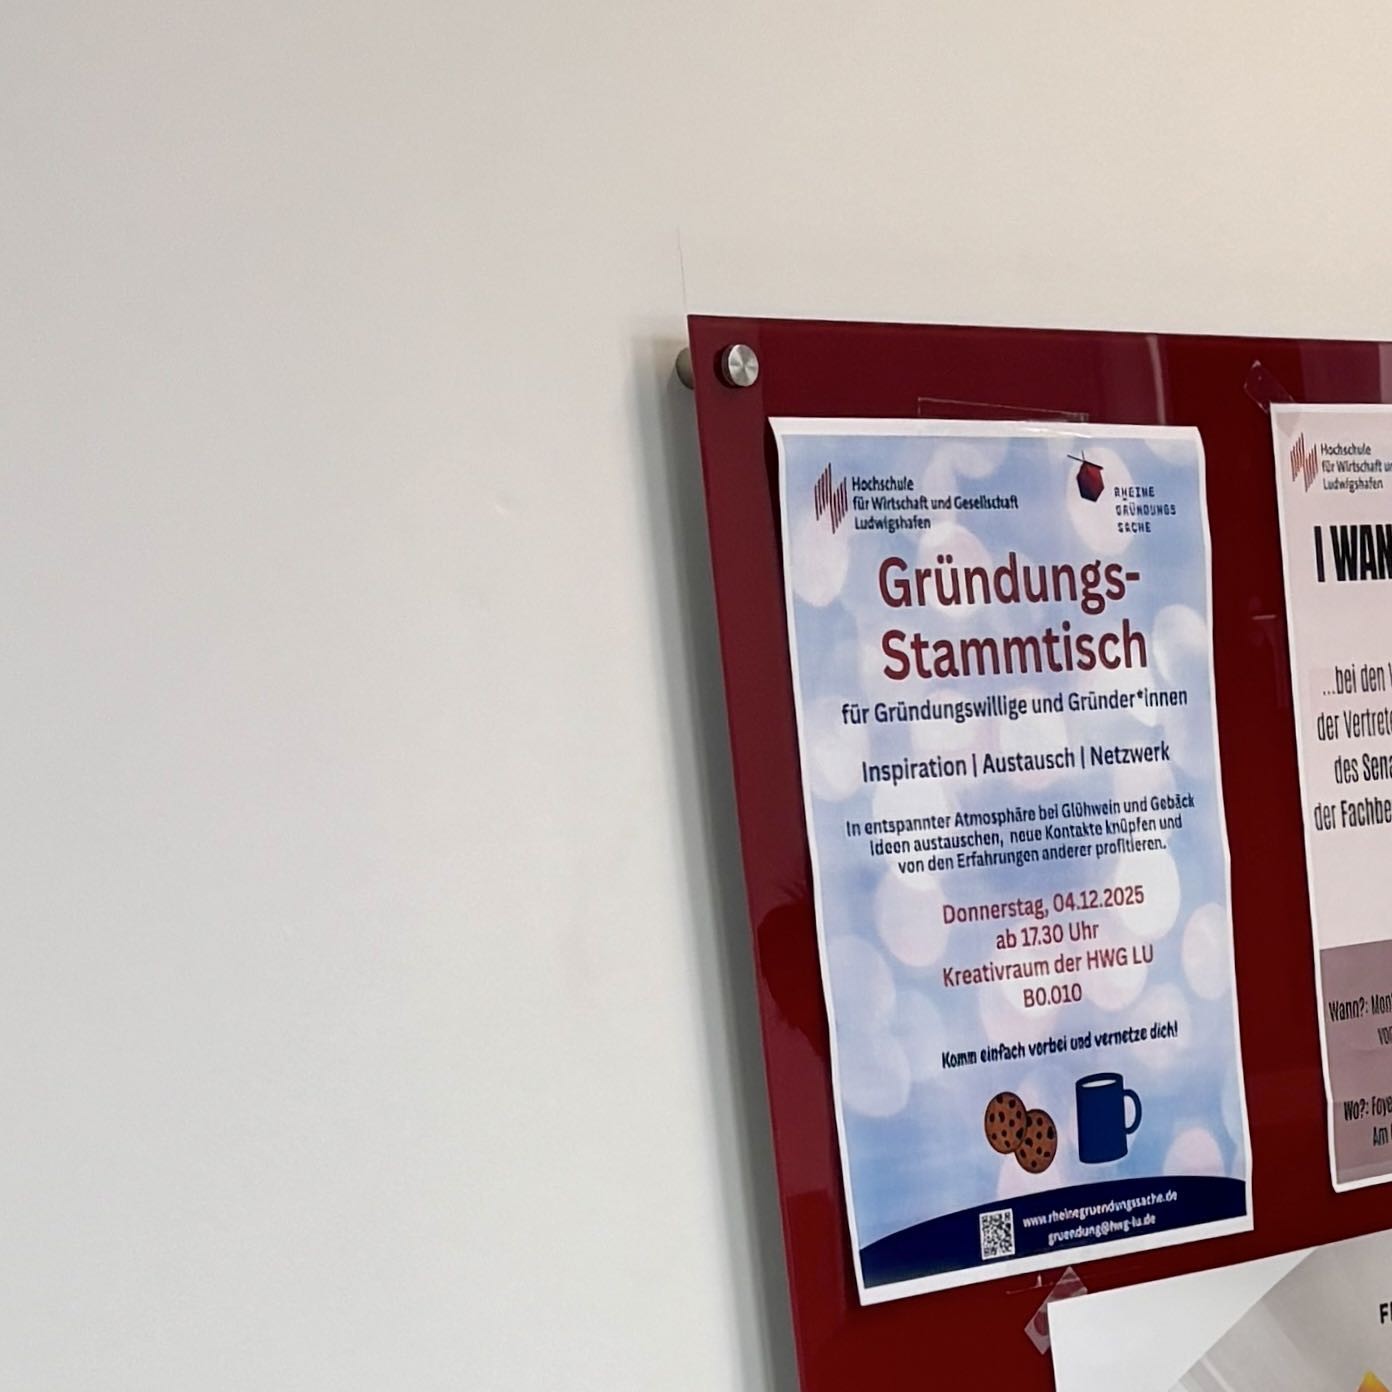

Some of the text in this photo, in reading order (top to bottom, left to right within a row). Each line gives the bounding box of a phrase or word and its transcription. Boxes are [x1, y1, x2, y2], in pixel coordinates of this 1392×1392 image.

[1321, 442, 1371, 455] Hochschule
[1322, 460, 1335, 472] für
[1336, 459, 1382, 472] Wirtschaft
[852, 475, 914, 491] Hochschule
[1114, 486, 1155, 497] RHEINE
[1323, 476, 1384, 493] Ludwigshafen
[853, 494, 1019, 510] für Wirtschaft und Gesellschaft
[1116, 502, 1176, 516] GRÜNDUNGS
[855, 515, 931, 533] Ludwigshafen
[1118, 522, 1151, 533] SACHE
[1313, 526, 1326, 582] I
[878, 551, 1140, 615] Gründungs-
[882, 619, 1148, 681] Stammtisch
[1361, 662, 1386, 692] den
[842, 703, 869, 724] für
[874, 694, 1027, 723] Gründungswillige
[1032, 693, 1064, 714] und
[1317, 712, 1340, 741] der
[862, 741, 1170, 786] Inspiration Austausch Netzwerk
[1334, 756, 1359, 784] des
[846, 793, 1195, 838] In entspannter Atmosphäre bei Glühwein und Gebäck
[1314, 803, 1336, 831] der
[870, 814, 1182, 856] Ideen austauschen, neue Kontakte knüpfen und
[898, 836, 1167, 874] von den Erfahrungen anderer profitieren.
[943, 885, 1145, 925] Donnerstag, 04.12.2025
[996, 921, 1100, 950] ab 17.30 Uhr
[943, 944, 1154, 988] Kreativraum der HWG LU
[1023, 983, 1082, 1008] B0.010
[1329, 996, 1368, 1022] Wann?:
[942, 1020, 1178, 1069] Komm einfach vorbei und vernetze dich!
[1344, 1098, 1369, 1121] Wo?:
[1373, 1126, 1389, 1146] Am
